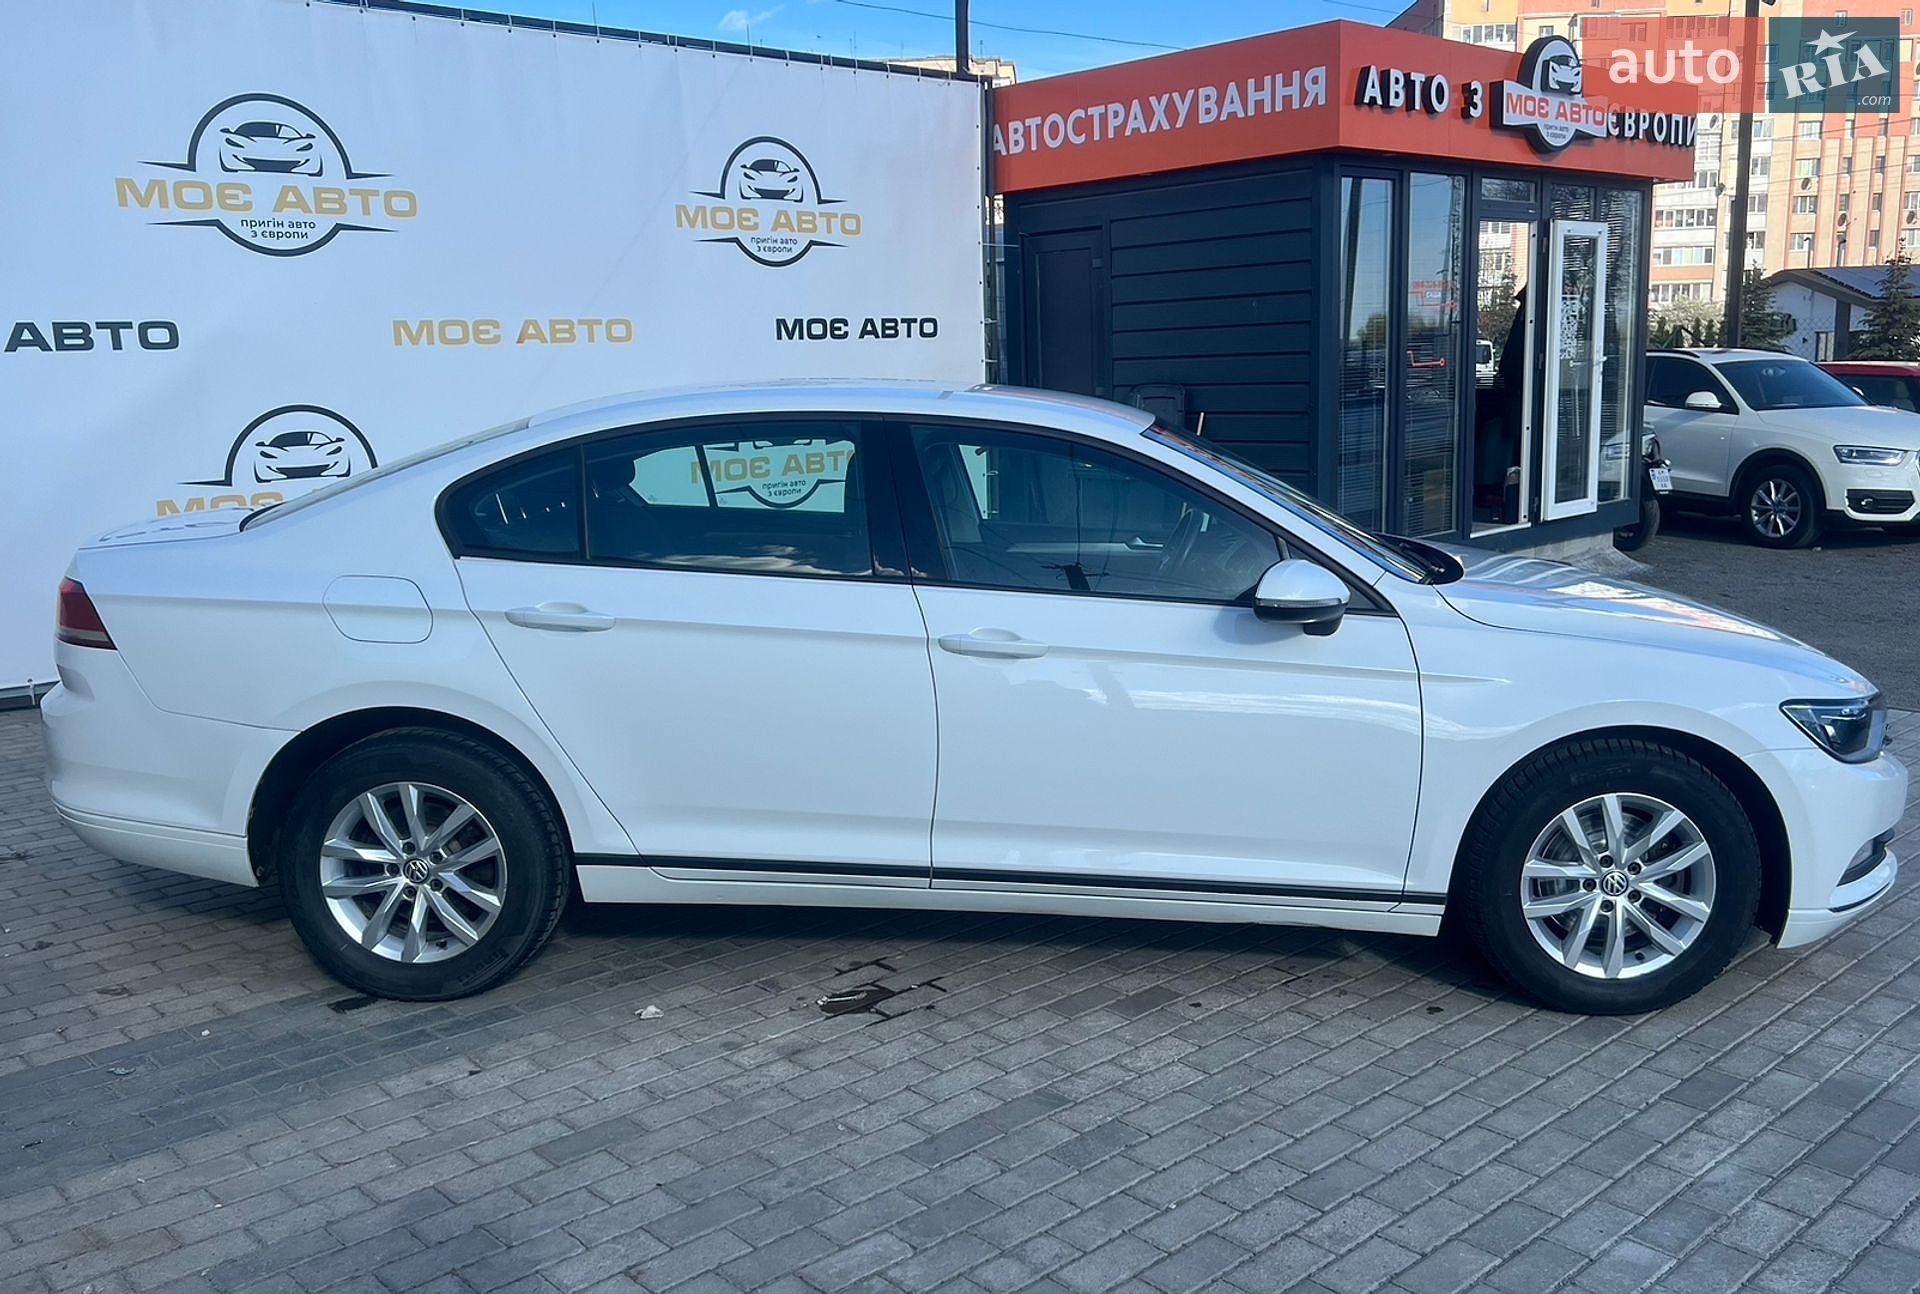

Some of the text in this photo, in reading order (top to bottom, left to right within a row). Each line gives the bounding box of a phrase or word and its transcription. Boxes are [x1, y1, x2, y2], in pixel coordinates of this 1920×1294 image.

[992, 65, 1327, 157] АВТОСТРАХУВАННЯ
[1357, 65, 1450, 114] АВТО
[1607, 103, 1697, 147] ЄВРОПИ
[1506, 92, 1605, 126] МОЄ АВТО
[114, 177, 418, 219] МОЄ АВТО
[240, 218, 317, 230] пригін авто
[261, 230, 309, 240] європи
[675, 204, 862, 236] МОЄ АВТО
[780, 238, 798, 246] авто
[4, 321, 180, 353] АВТО
[392, 318, 634, 347] МОЄ АВТО
[775, 317, 939, 341] МОЄ АВТО
[782, 448, 855, 477] АВТ
